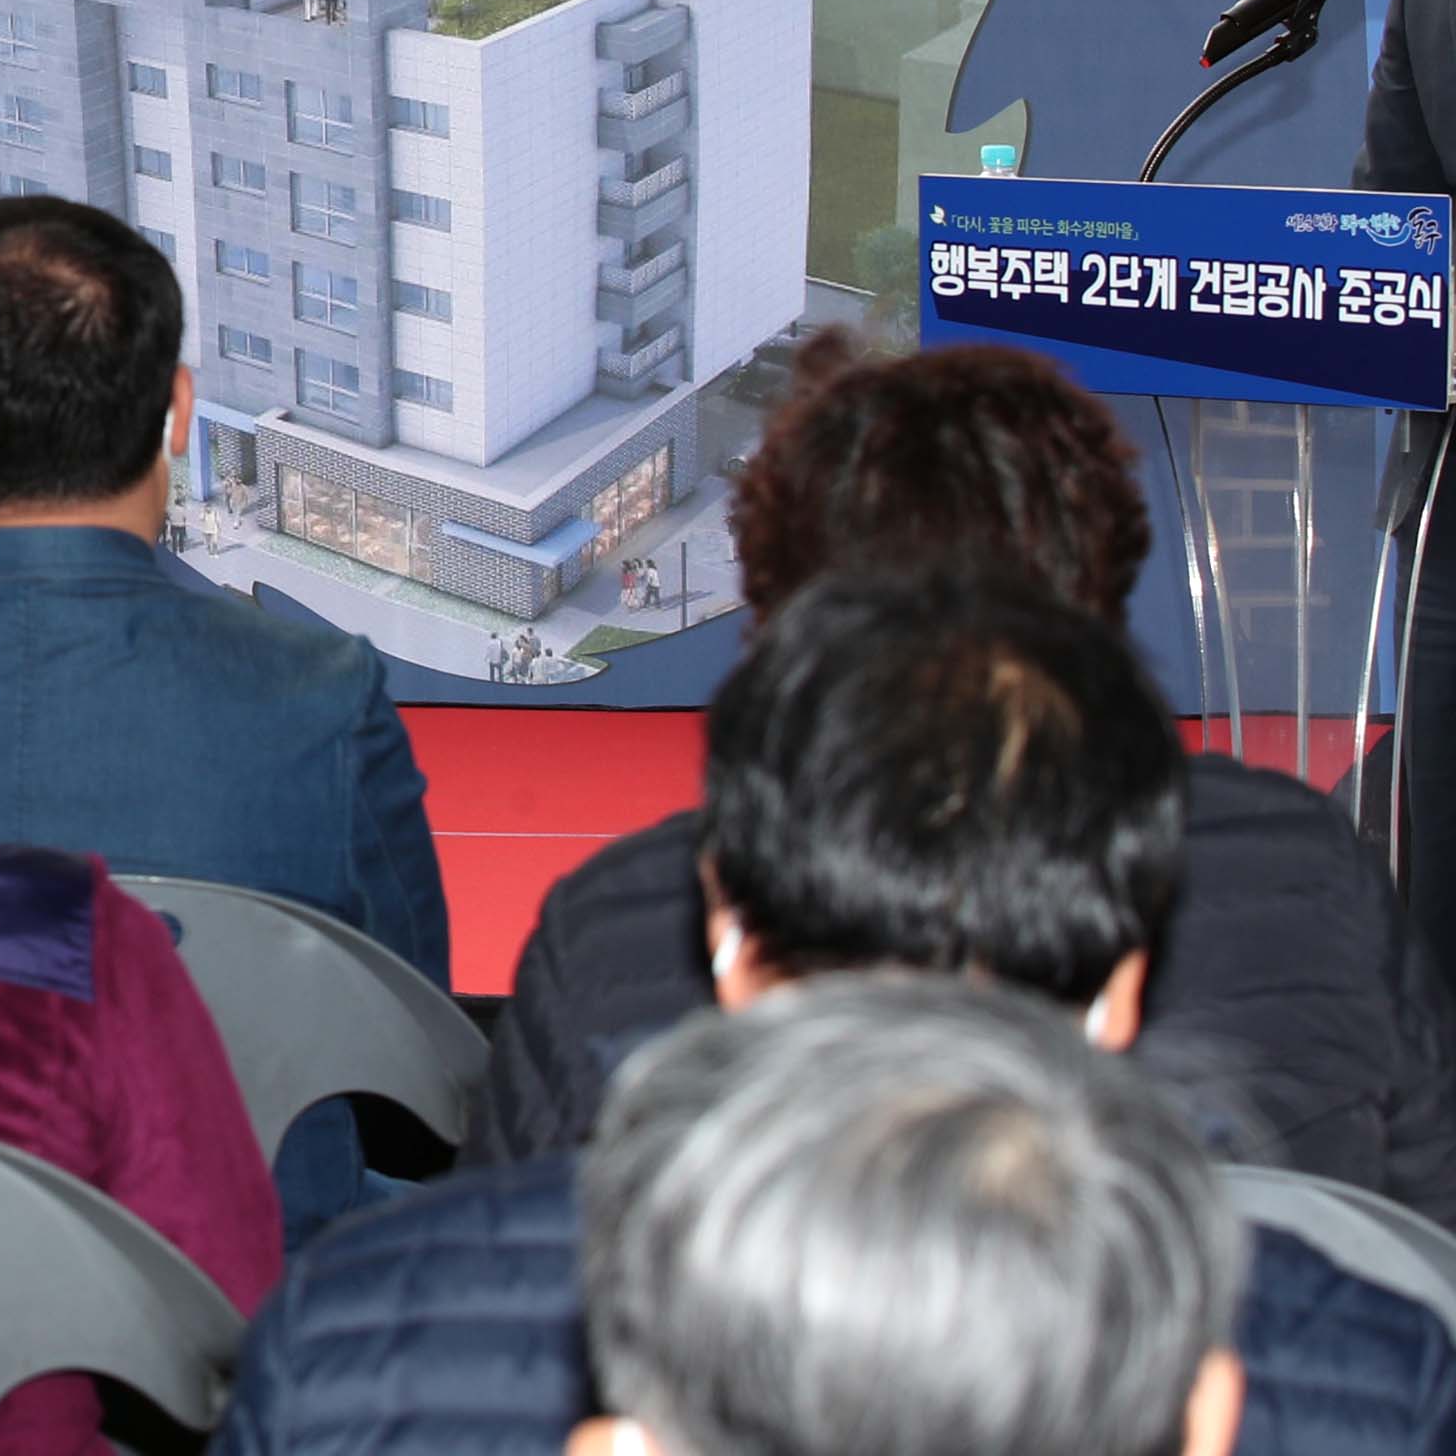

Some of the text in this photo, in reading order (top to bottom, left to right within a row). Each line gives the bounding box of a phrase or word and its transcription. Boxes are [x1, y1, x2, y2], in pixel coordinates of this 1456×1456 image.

[1017, 218, 1054, 237] 피우는
[930, 242, 1441, 328] 행복주택 2단계 건립공사 준공식
